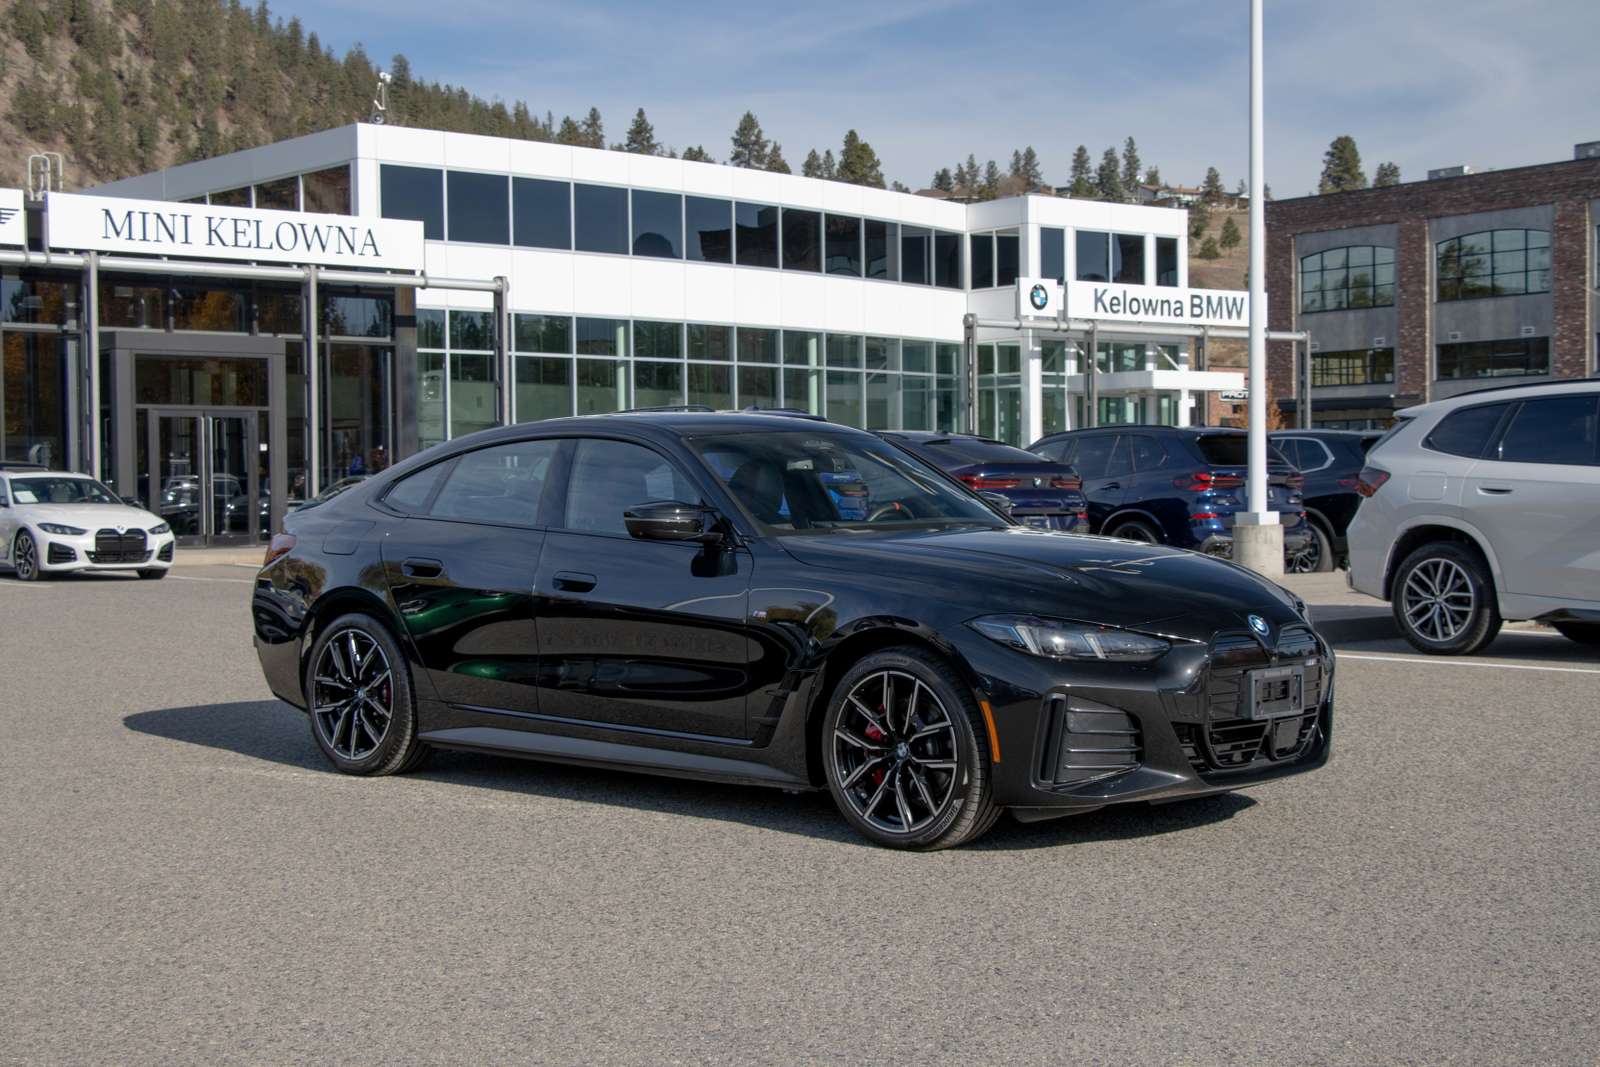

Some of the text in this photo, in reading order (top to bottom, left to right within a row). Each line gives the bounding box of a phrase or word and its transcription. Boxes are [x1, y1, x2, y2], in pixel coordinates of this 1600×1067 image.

[102, 208, 382, 257] MINI KELOWNA
[1093, 288, 1245, 321] Kelowna BMW
